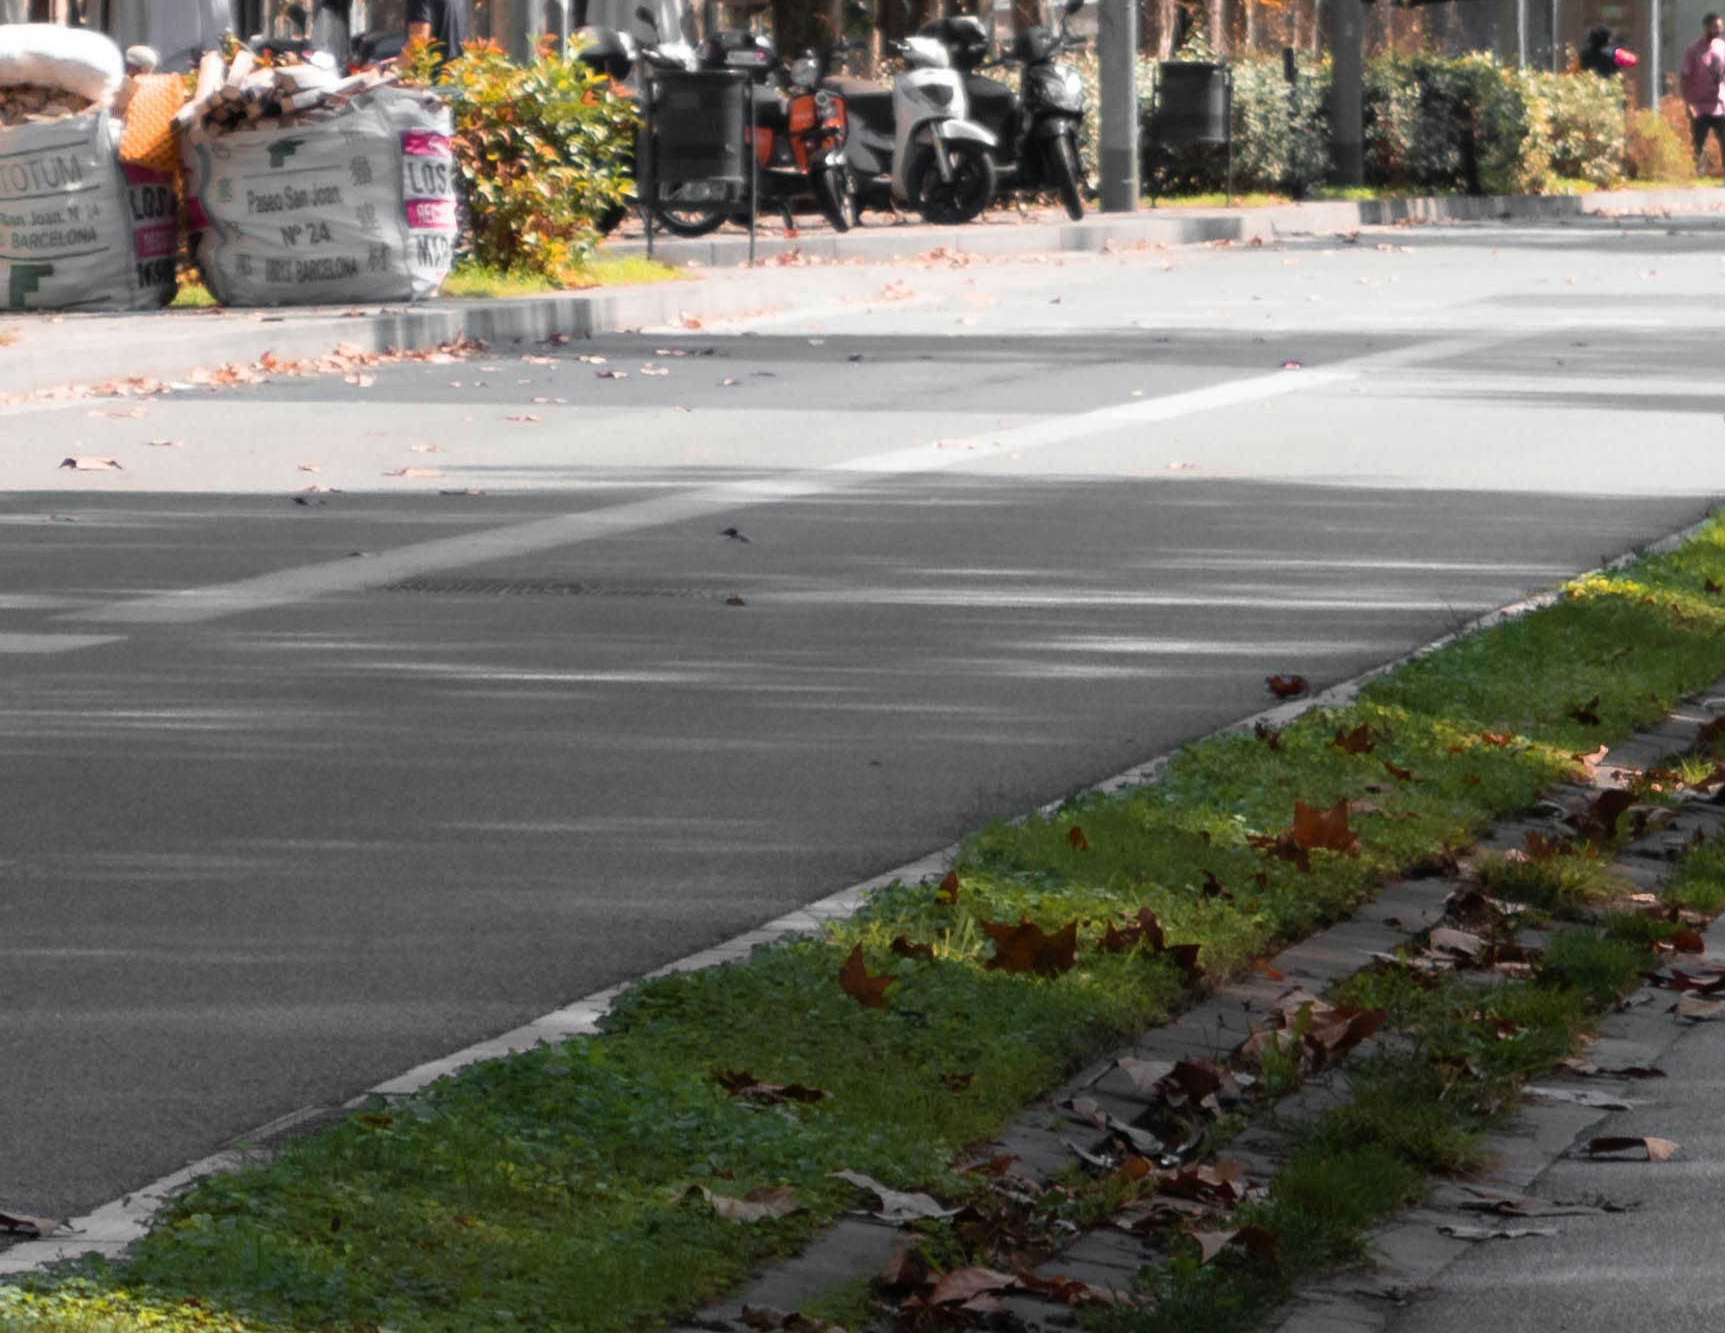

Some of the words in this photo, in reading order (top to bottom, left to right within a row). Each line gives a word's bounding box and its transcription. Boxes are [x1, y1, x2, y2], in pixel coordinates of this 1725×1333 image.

[246, 188, 283, 214] Paseo
[285, 184, 308, 209] San
[12, 225, 97, 250] BARCELONA
[296, 255, 359, 283] BARCELONA
